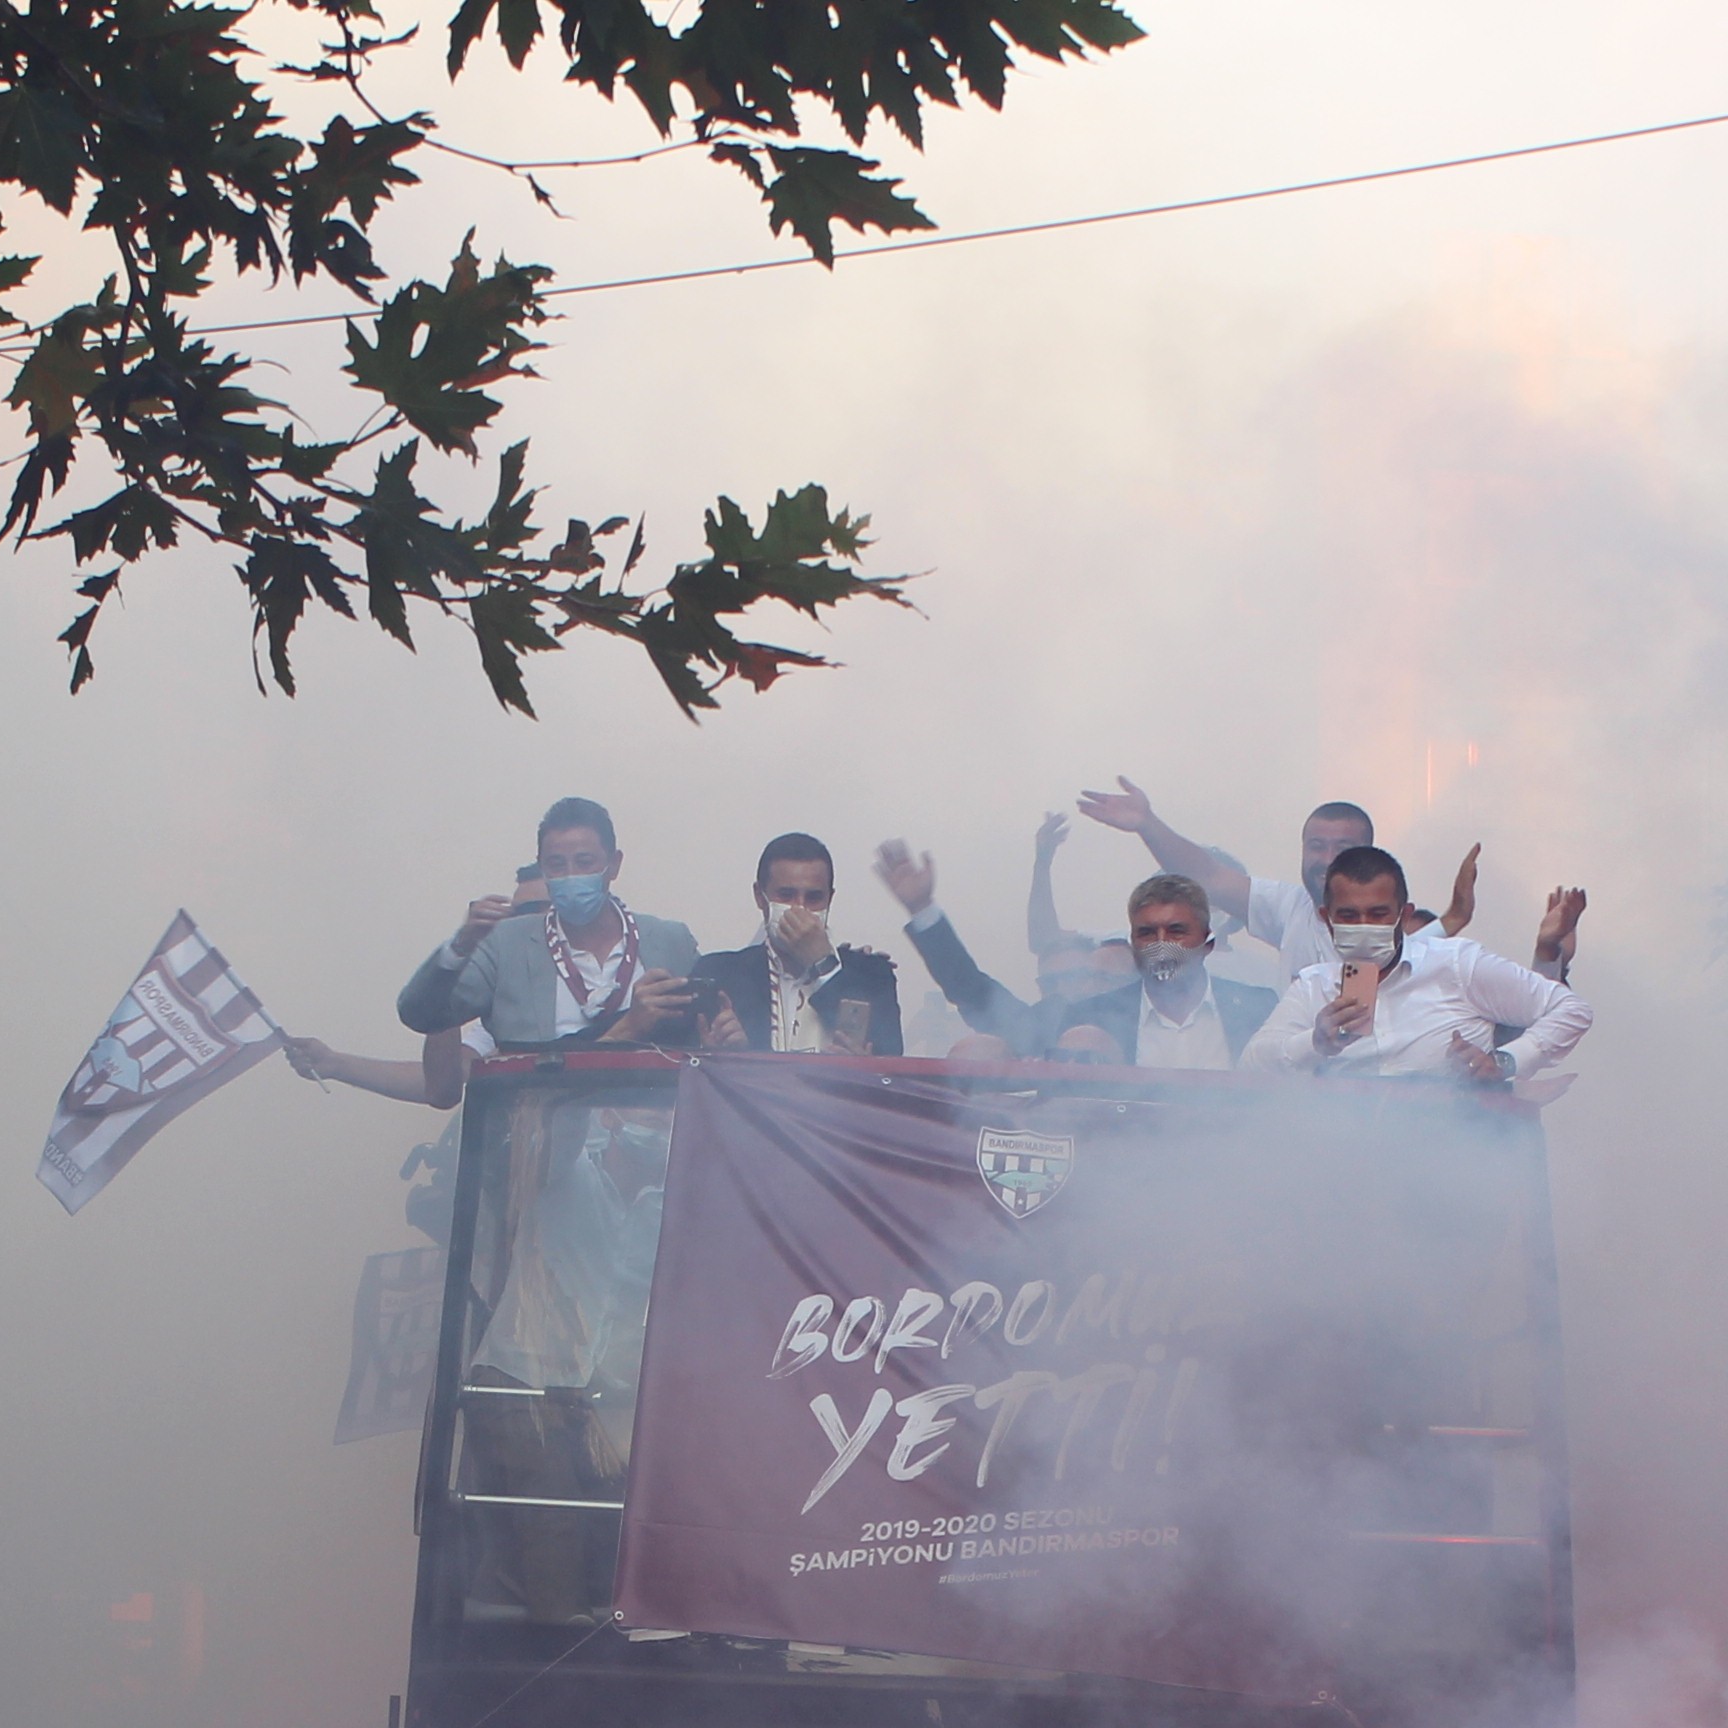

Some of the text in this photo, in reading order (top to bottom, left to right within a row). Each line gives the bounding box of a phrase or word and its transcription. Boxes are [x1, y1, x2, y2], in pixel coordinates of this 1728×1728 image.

[988, 1138, 1064, 1154] BANDIRMASPOR
[859, 1504, 1114, 1543] 2019-2020 SEZONU
[960, 1526, 1181, 1562] BANDIRMASPOR
